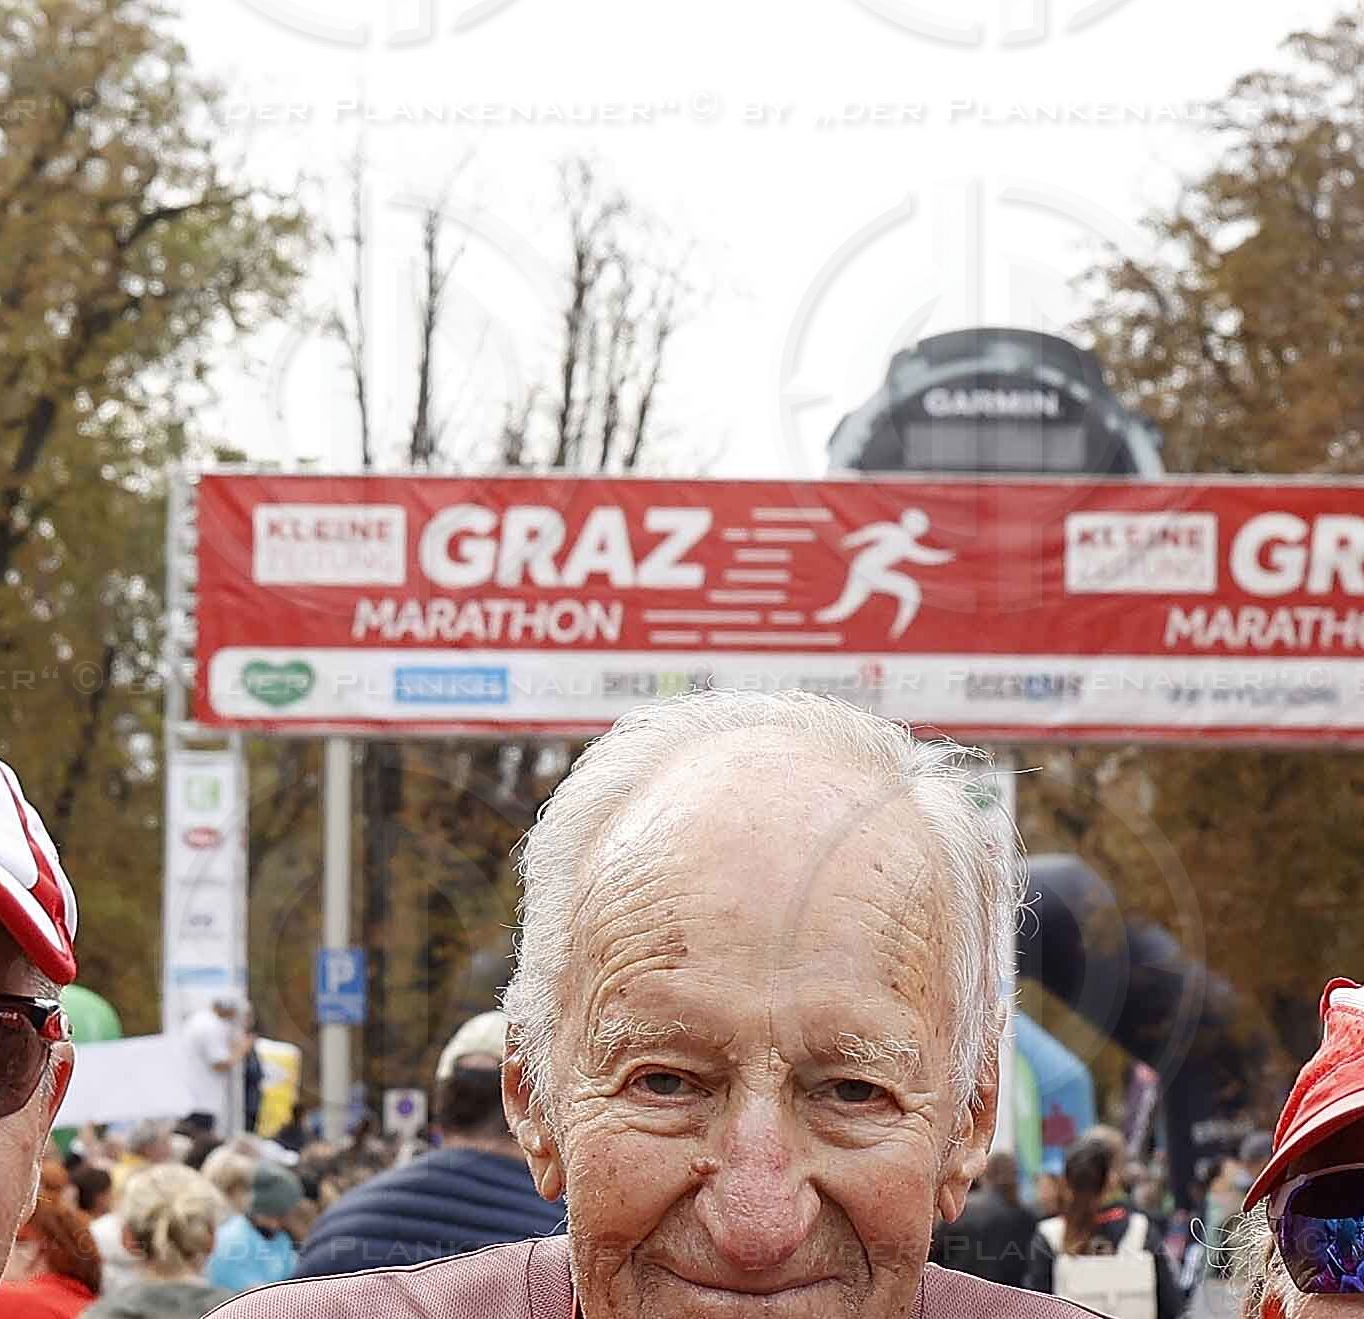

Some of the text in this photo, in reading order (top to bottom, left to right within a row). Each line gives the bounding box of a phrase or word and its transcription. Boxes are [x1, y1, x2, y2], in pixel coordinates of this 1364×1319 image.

[266, 517, 393, 542] KLEINE
[419, 504, 714, 589] GRAZ
[350, 599, 624, 643] MARATHON
[326, 950, 356, 994] P
